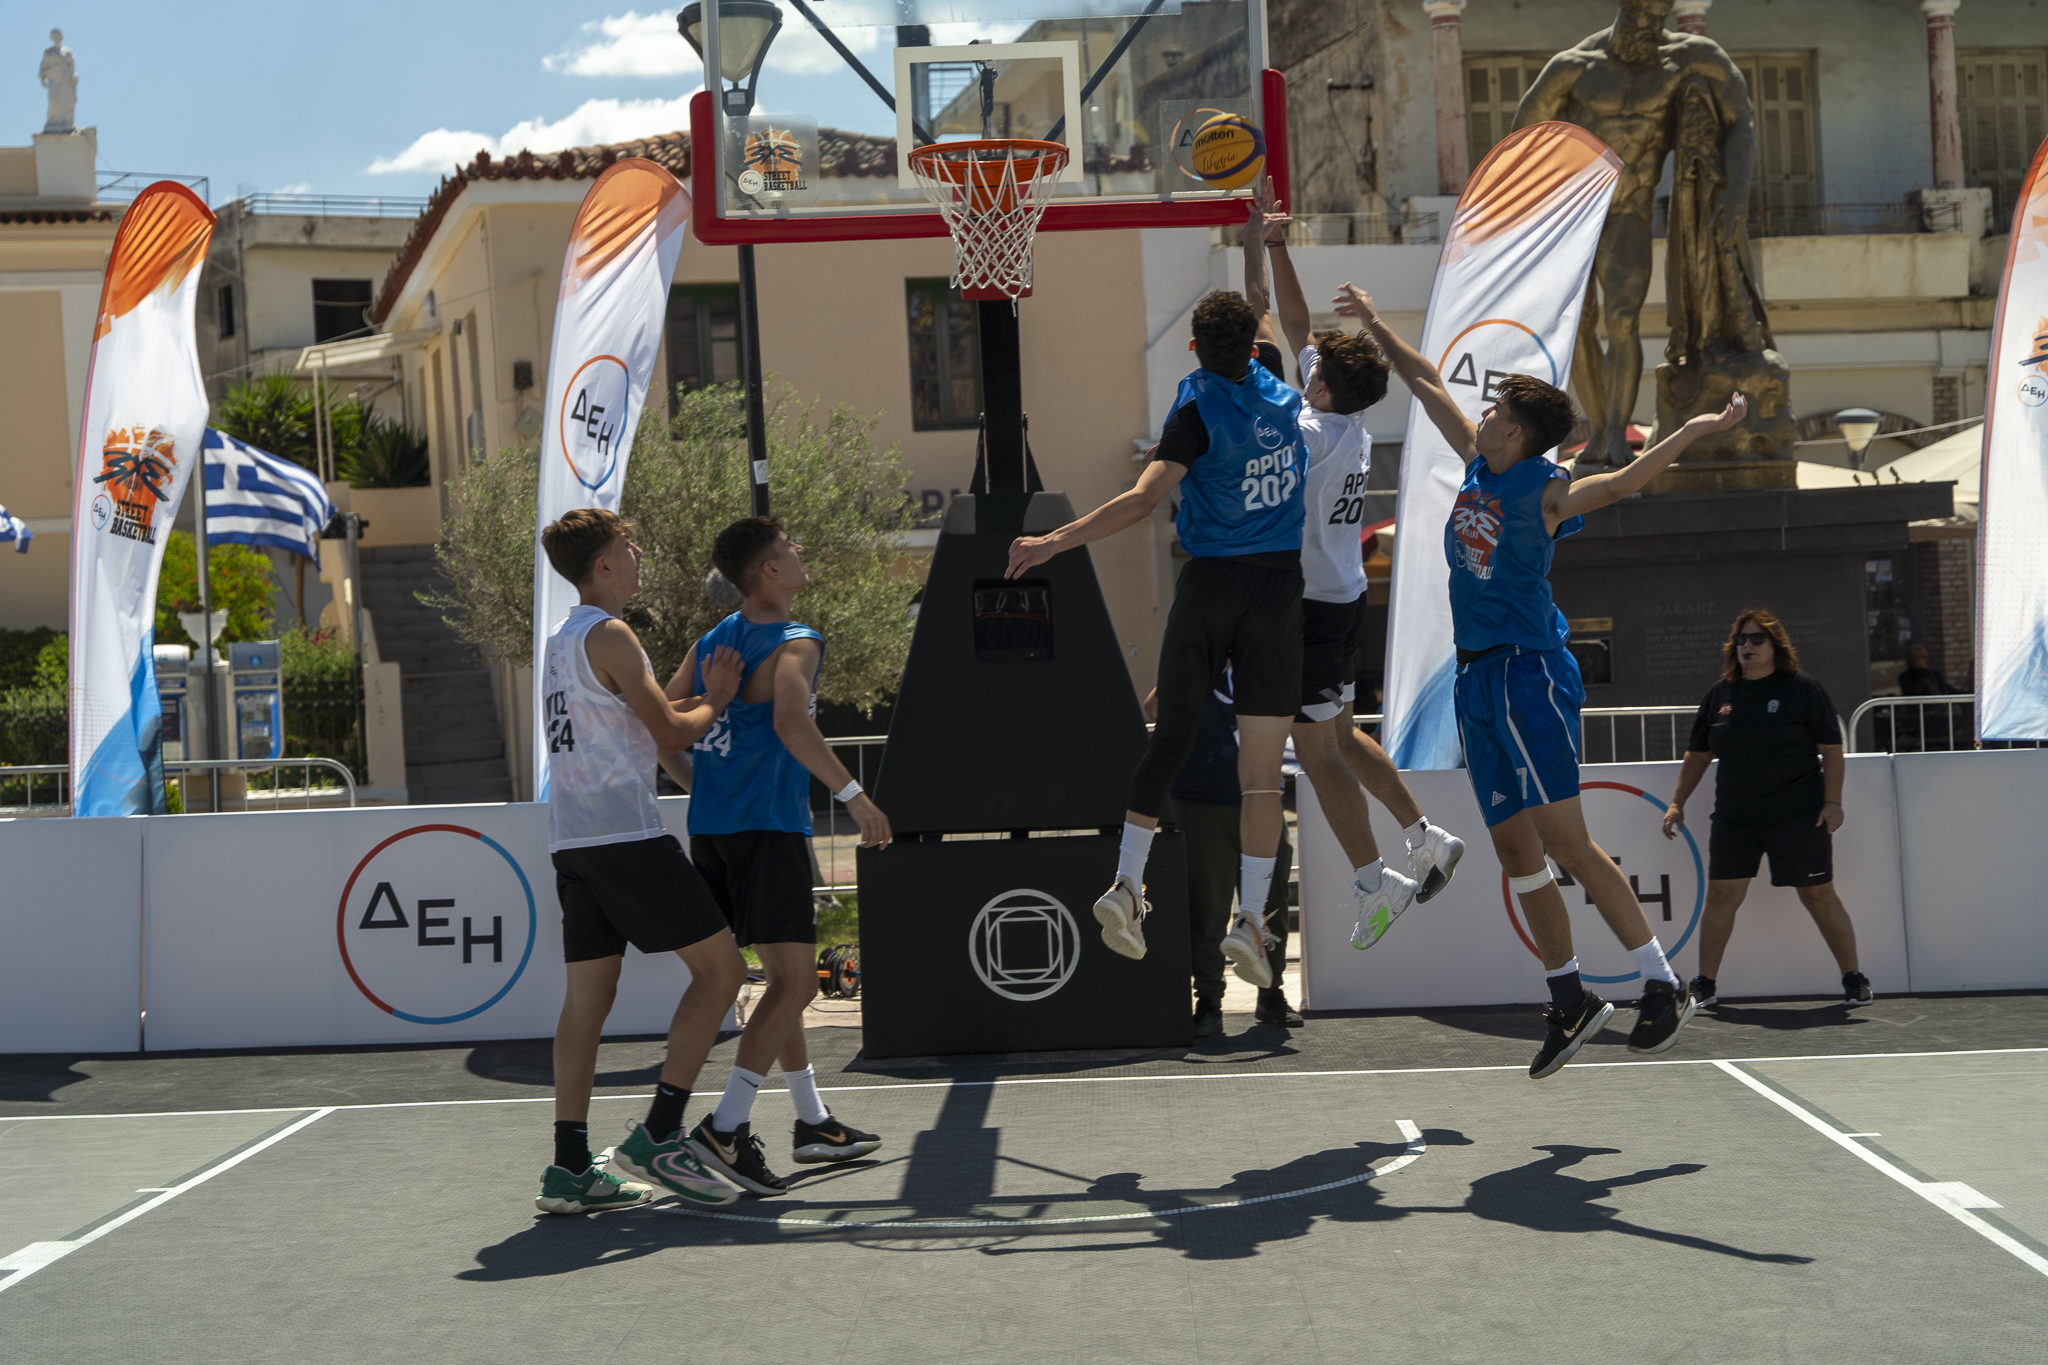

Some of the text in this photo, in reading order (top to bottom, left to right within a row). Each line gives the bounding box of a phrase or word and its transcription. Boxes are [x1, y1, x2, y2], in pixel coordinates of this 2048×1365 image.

[1195, 130, 1235, 150] molten
[743, 177, 758, 187] ΔΕΗ
[763, 170, 791, 181] STREET
[763, 179, 808, 192] BASKETBALL
[1448, 352, 1508, 403] ΔΕ
[2020, 383, 2046, 399] ΔΕΗ
[571, 388, 614, 456] ΔΕΗ
[1245, 440, 1297, 477] ΑΡΓΟ
[1240, 470, 1301, 512] 202
[1342, 471, 1370, 496] ΑΡΓ
[93, 503, 107, 521] ΔΕΗ
[115, 498, 149, 524] STREET
[1328, 496, 1364, 526] 20
[109, 516, 157, 546] BASKETBALL
[1643, 602, 1717, 616] ΗΡΑΚΛΗΣ
[1648, 693, 1705, 705] HERAC
[547, 719, 575, 754] 24
[694, 722, 731, 757] 24
[1516, 767, 1528, 800] 7
[358, 882, 502, 964] ΔΕΗ
